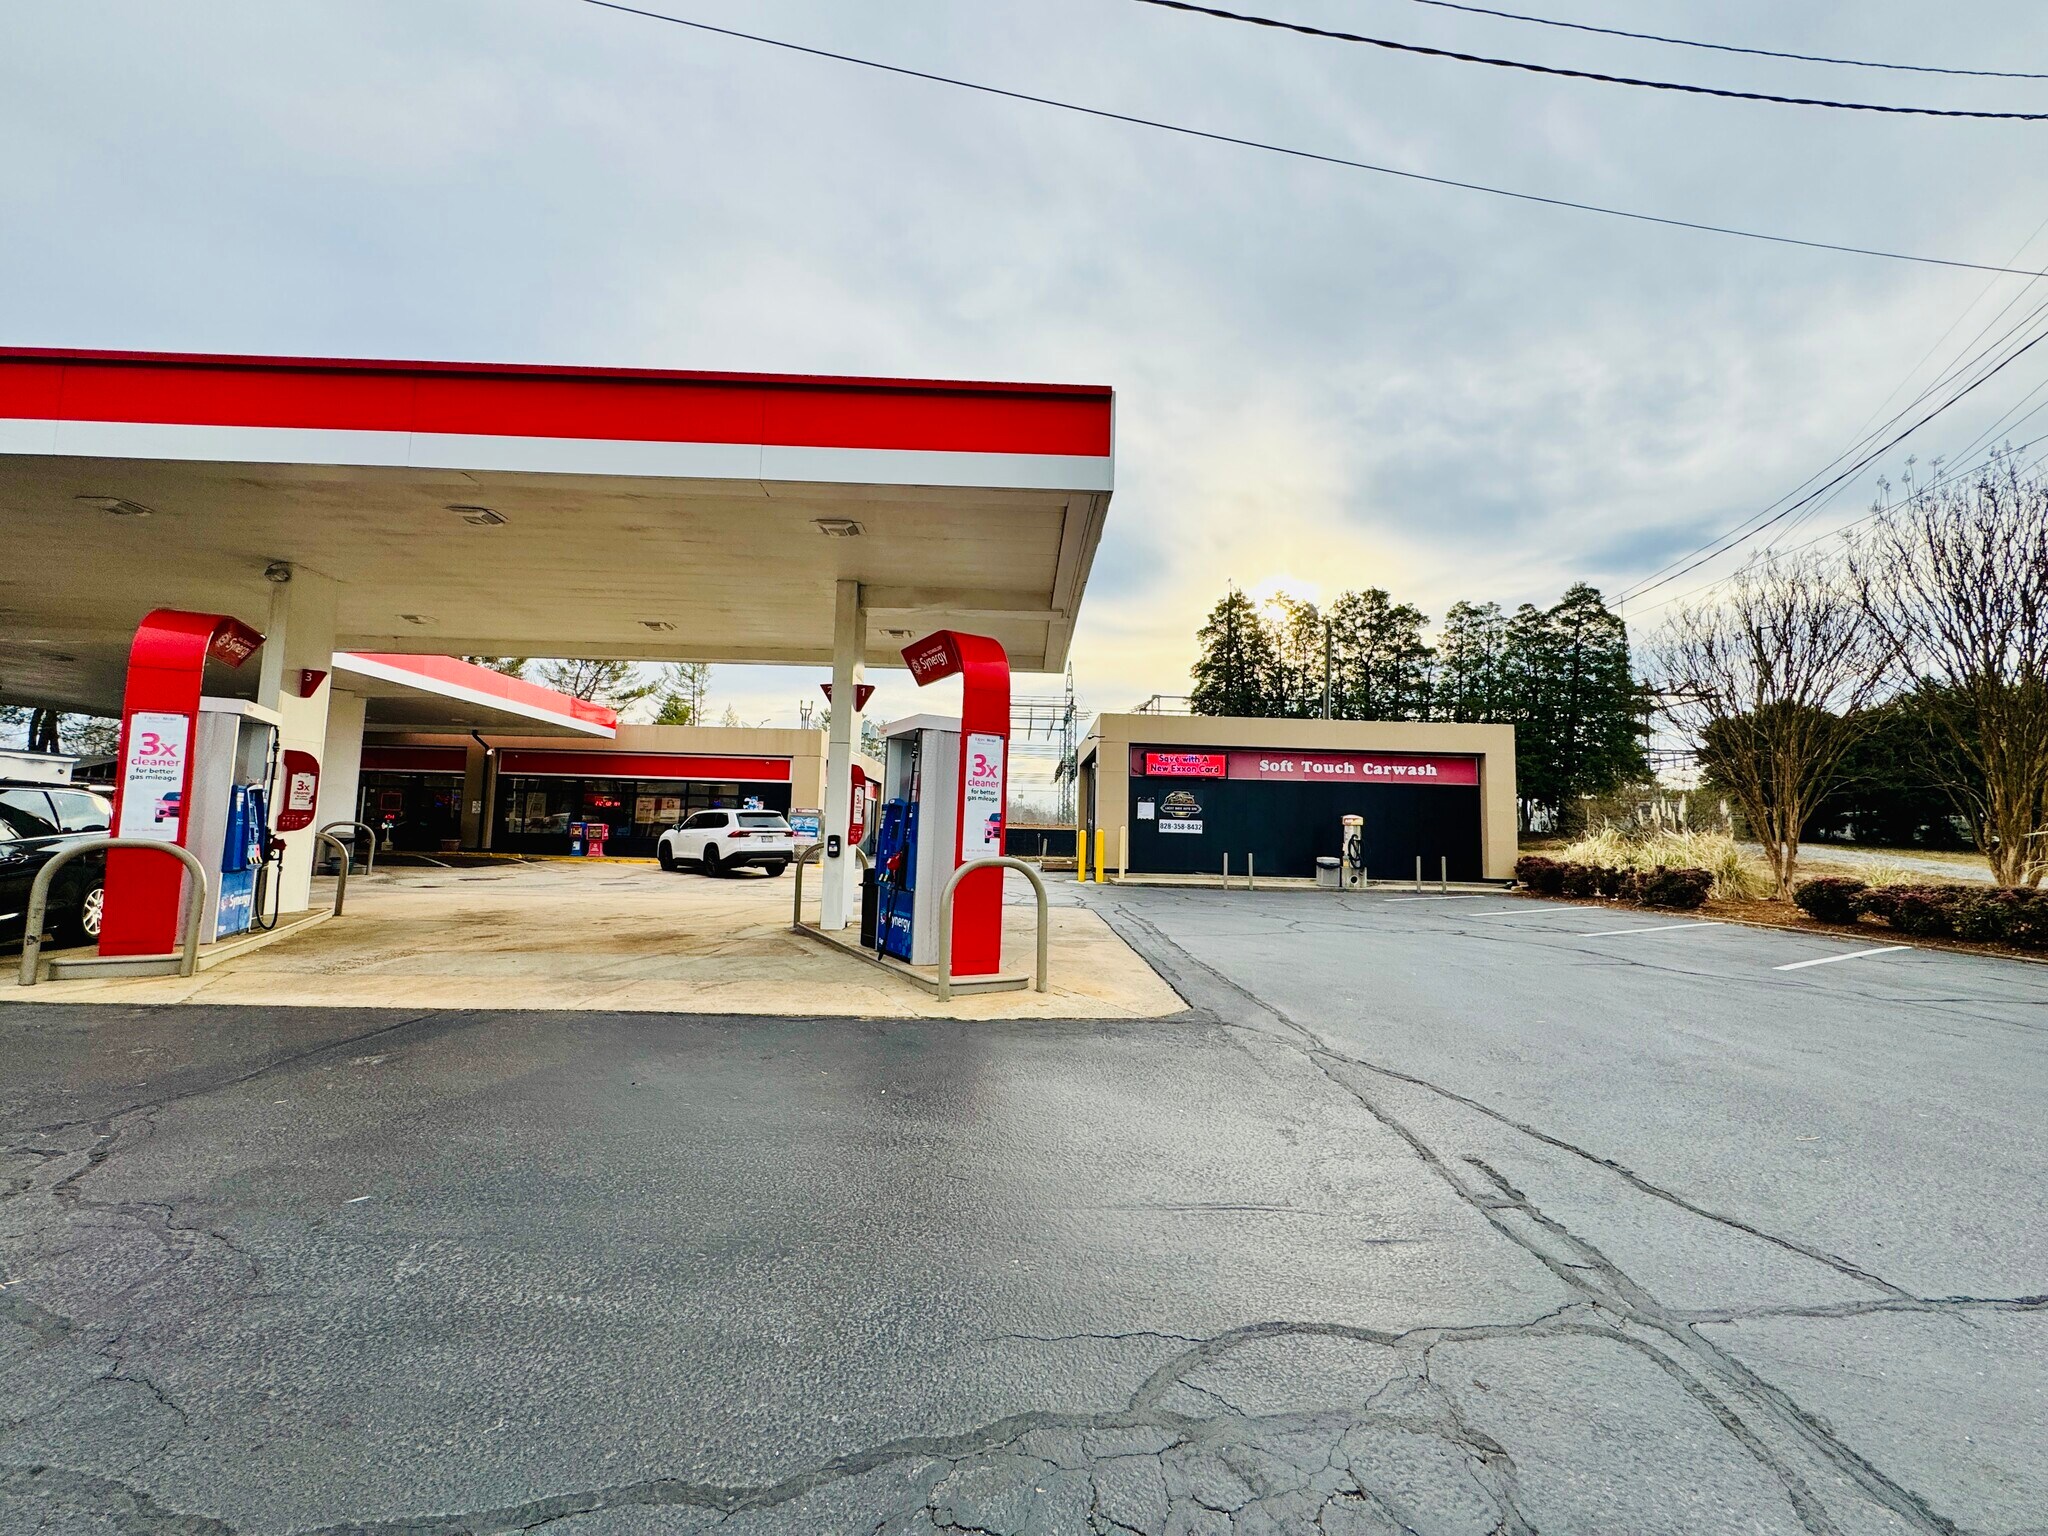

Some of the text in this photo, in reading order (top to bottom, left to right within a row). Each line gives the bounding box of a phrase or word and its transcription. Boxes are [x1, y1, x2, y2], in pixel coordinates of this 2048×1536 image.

[225, 637, 252, 660] Synergy
[919, 650, 949, 672] Synergy
[305, 672, 313, 682] 3
[860, 687, 866, 697] 1
[139, 732, 178, 758] 3x
[131, 756, 181, 768] cleaner
[1159, 754, 1209, 764] Save with A
[135, 767, 175, 776] for better
[972, 753, 998, 779] 3x
[1150, 763, 1219, 774] New Exxon Card
[1259, 760, 1438, 777] Soft Touch Carwash
[129, 774, 177, 784] gas mileage
[967, 778, 1000, 789] cleaner
[296, 780, 310, 792] 3x
[970, 787, 996, 797] for better
[967, 795, 998, 804] gas mileage
